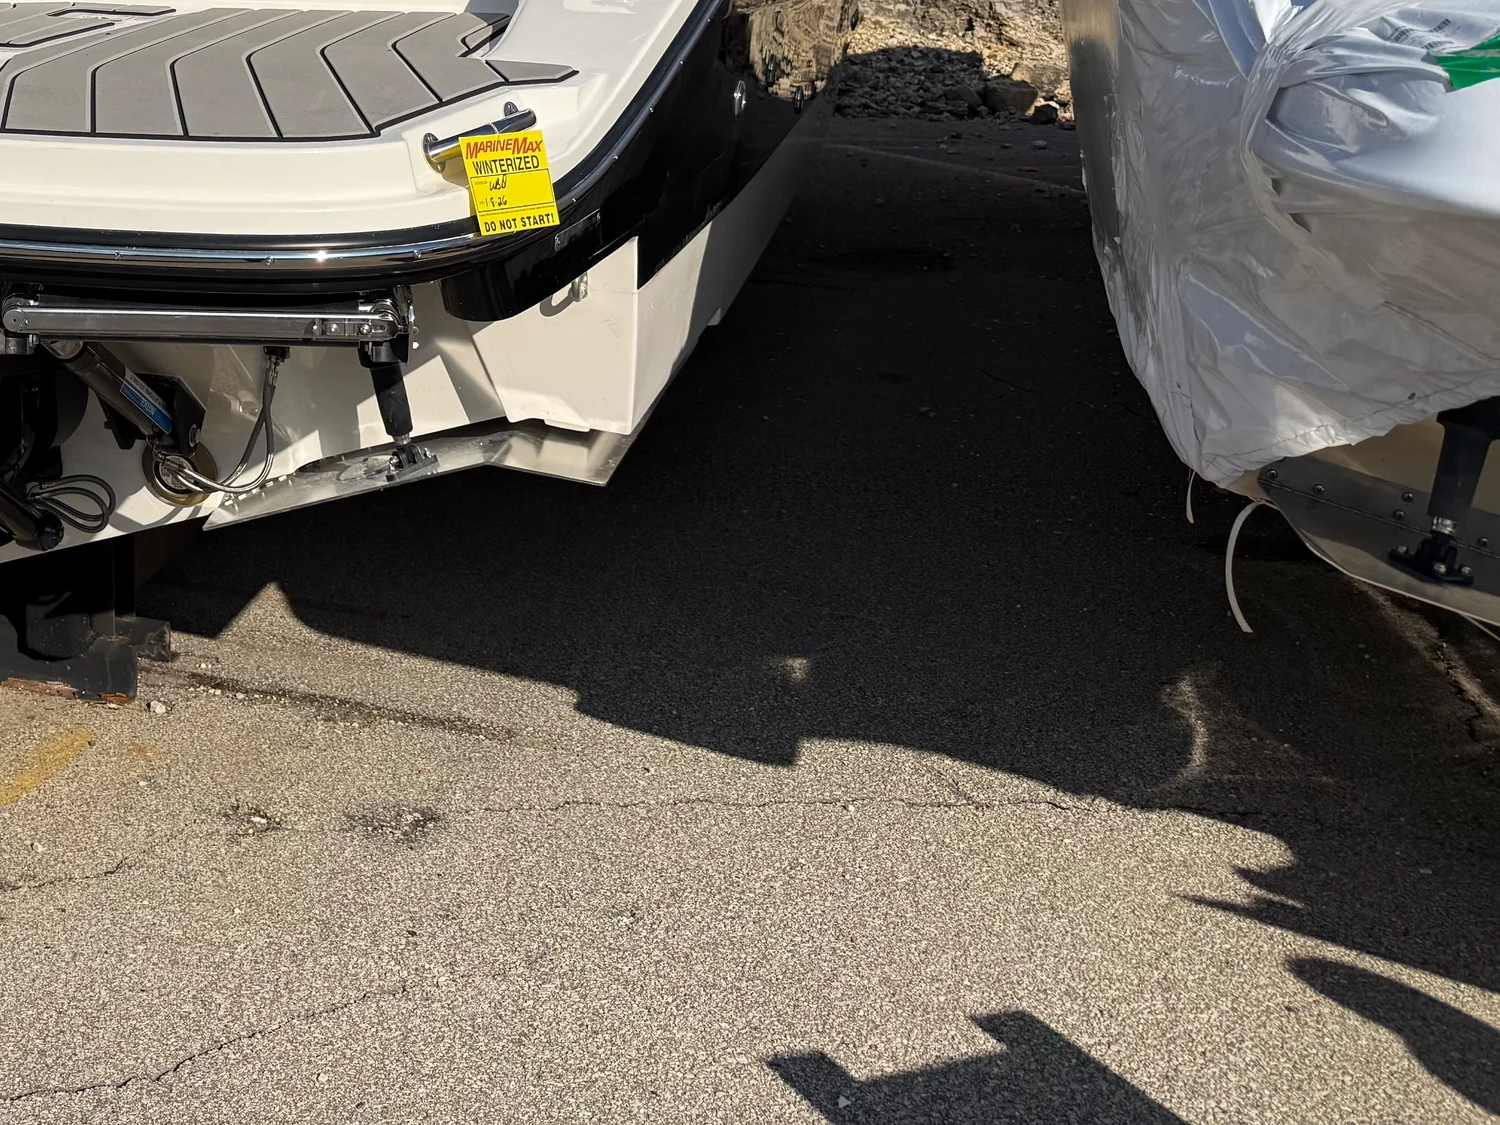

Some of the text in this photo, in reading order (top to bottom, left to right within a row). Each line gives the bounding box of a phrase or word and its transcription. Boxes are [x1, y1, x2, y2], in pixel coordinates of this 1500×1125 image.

[472, 155, 539, 175] WINTERIZED
[484, 213, 555, 232] DO NOT START!
